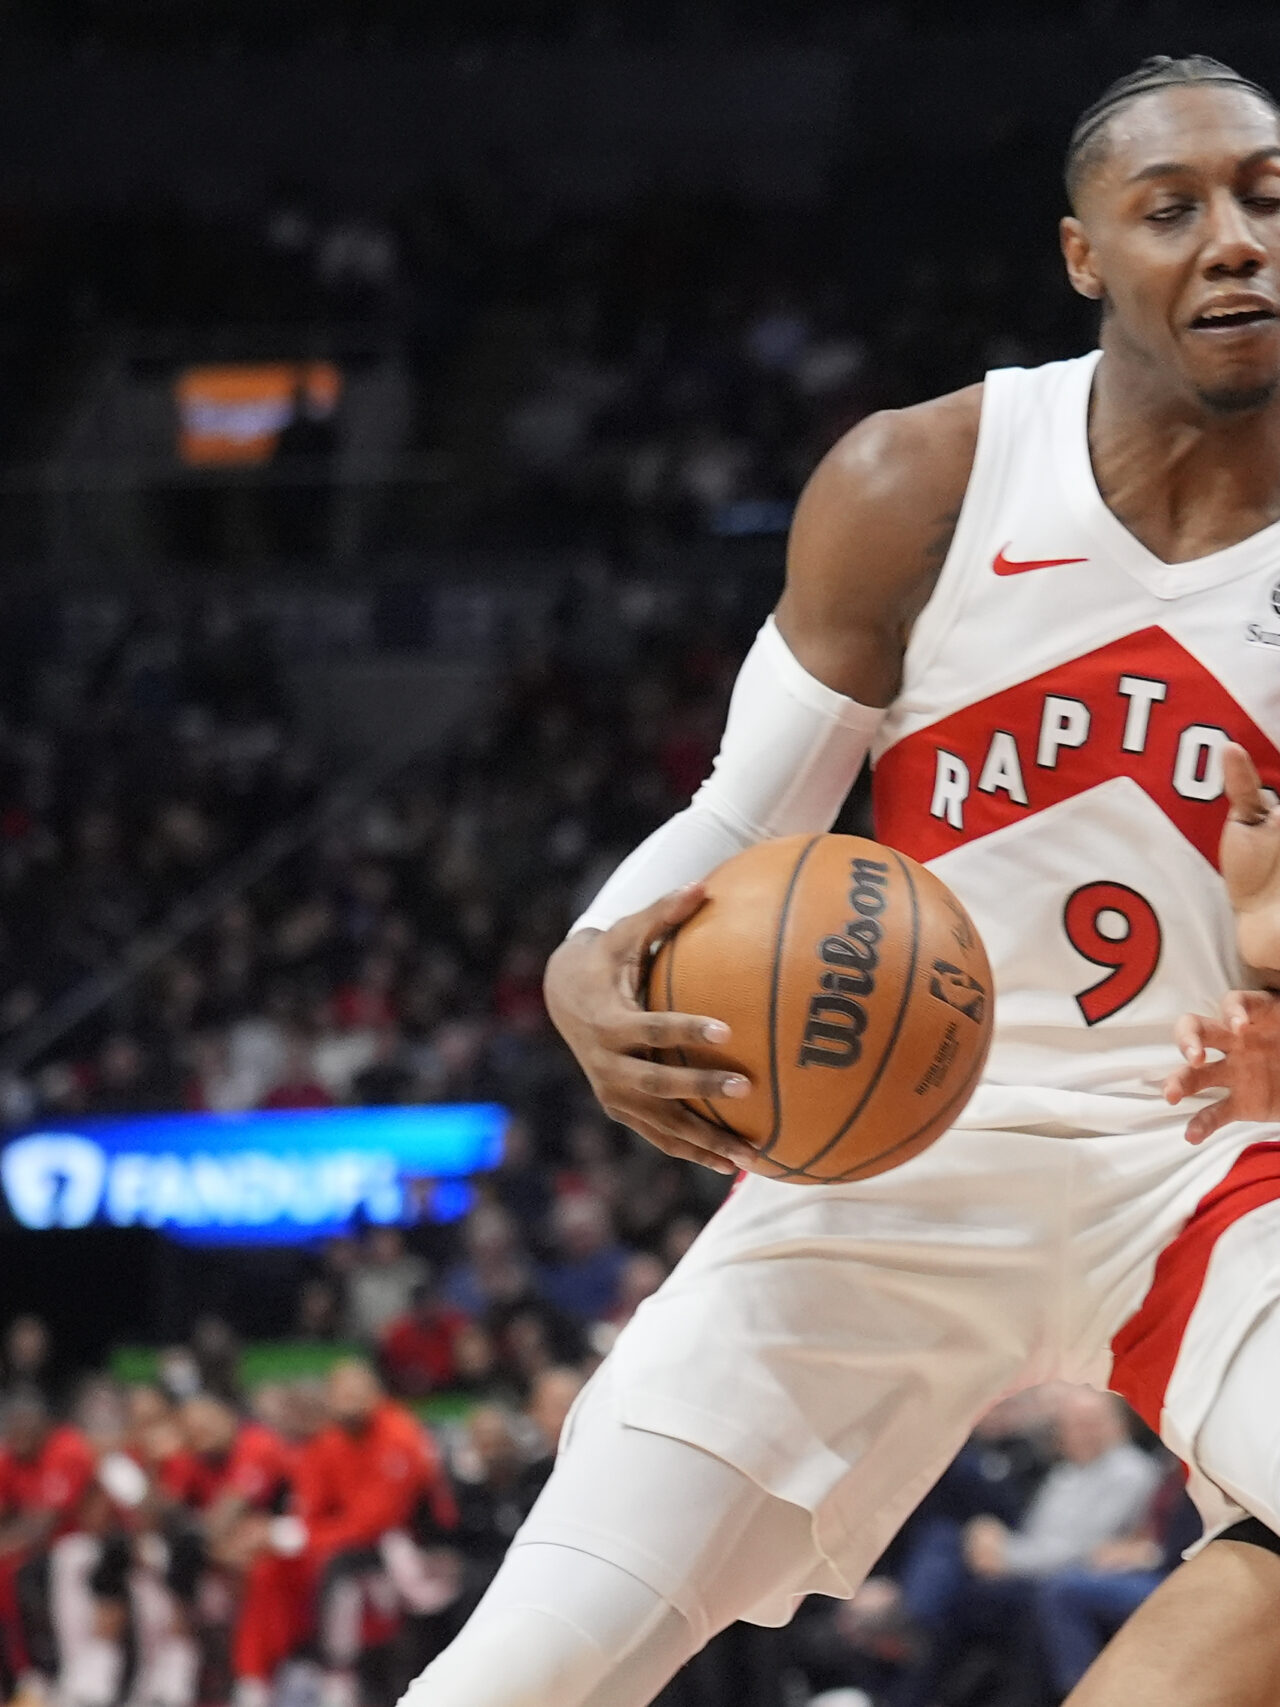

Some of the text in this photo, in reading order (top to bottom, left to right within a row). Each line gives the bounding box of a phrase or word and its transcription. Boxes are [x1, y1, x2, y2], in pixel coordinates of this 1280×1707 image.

[929, 673, 1280, 831] RAPTO
[796, 857, 889, 1069] Wilson
[1063, 880, 1162, 1027] 9
[104, 1150, 408, 1229] FANDUE
